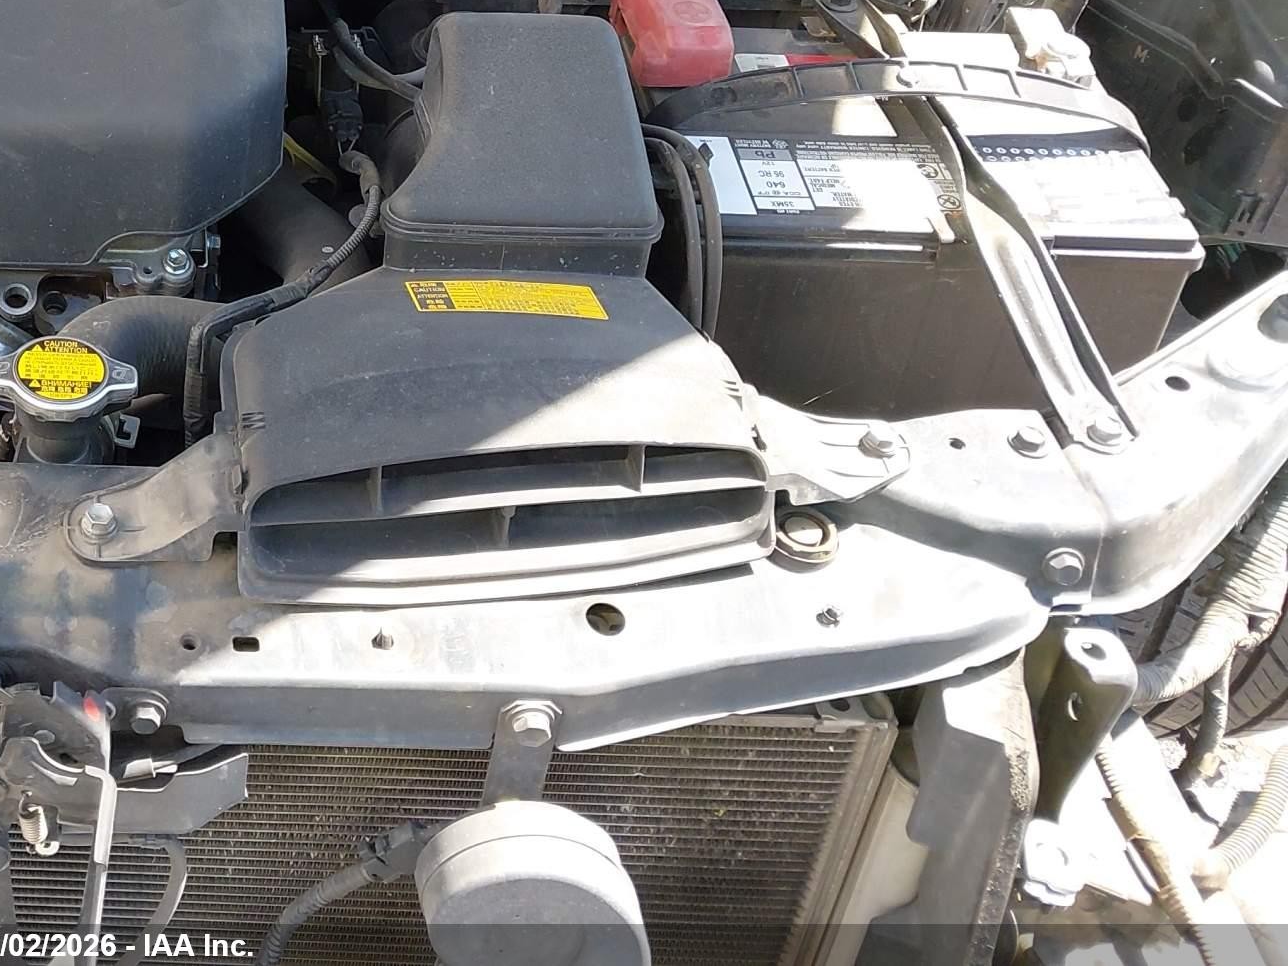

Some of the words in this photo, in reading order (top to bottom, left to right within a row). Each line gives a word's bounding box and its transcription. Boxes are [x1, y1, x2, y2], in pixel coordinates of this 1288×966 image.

[754, 150, 777, 159] Pb
[766, 180, 786, 188] 640
[43, 340, 78, 348] CAUTION
